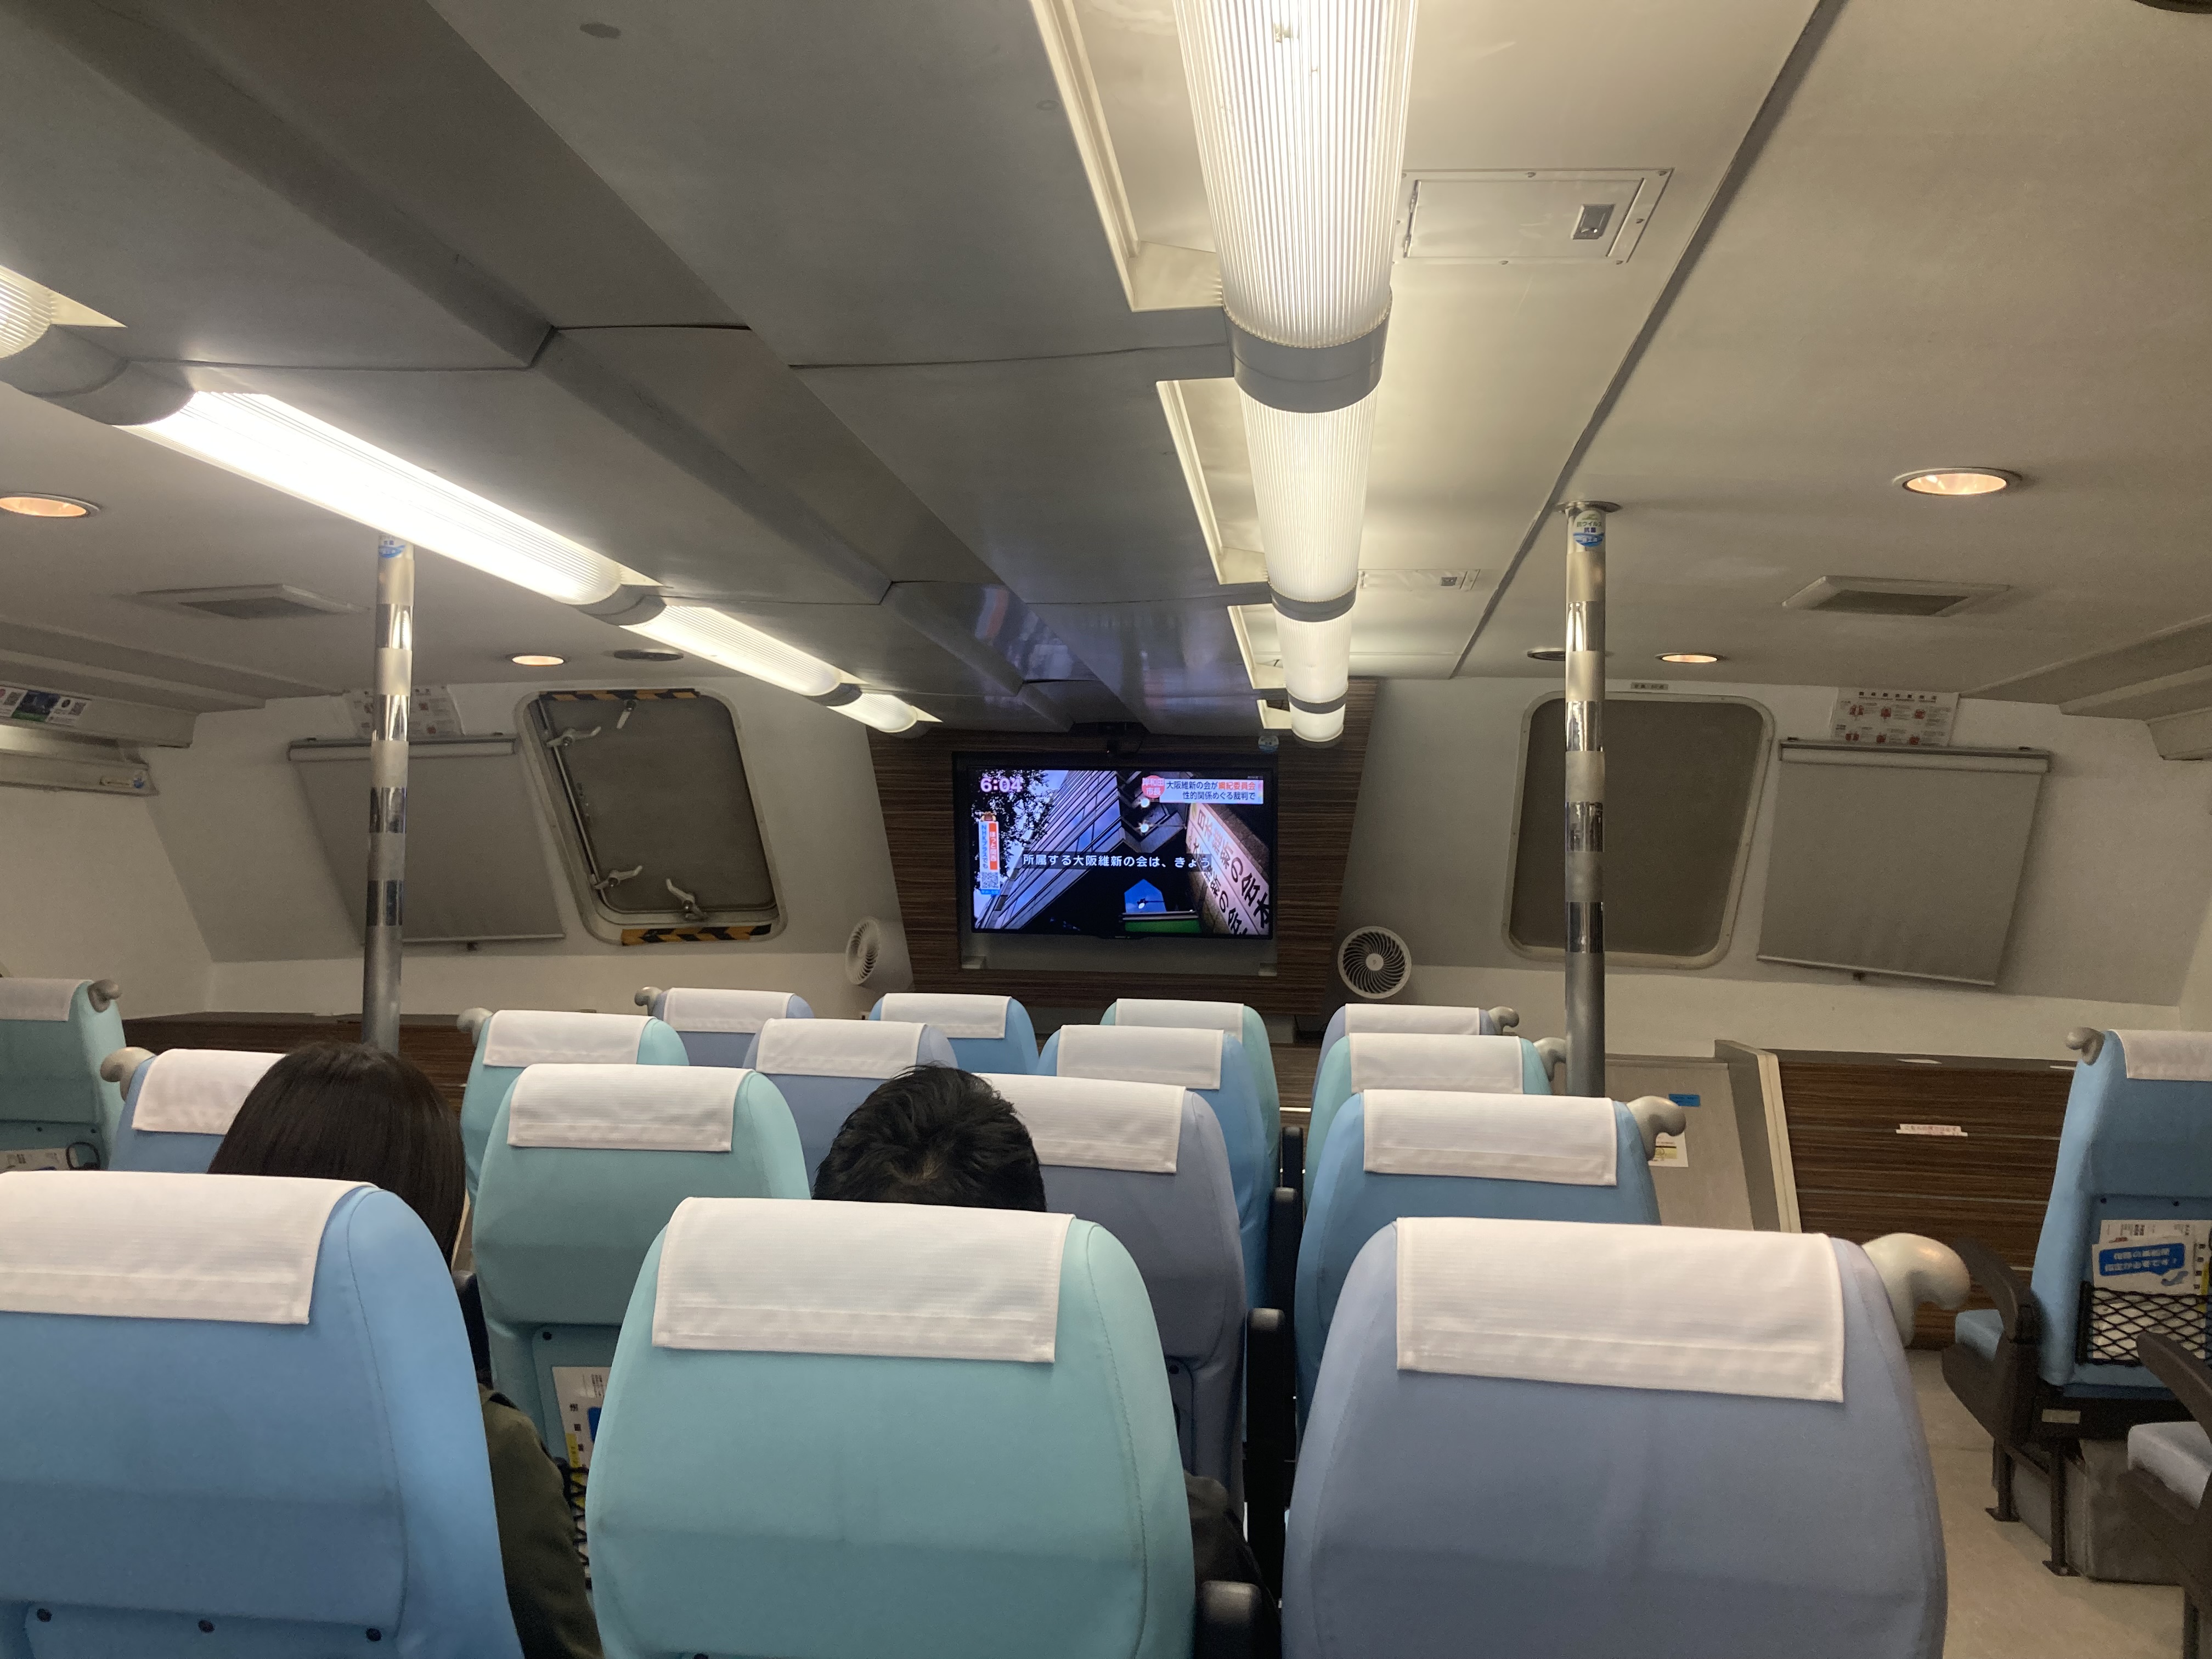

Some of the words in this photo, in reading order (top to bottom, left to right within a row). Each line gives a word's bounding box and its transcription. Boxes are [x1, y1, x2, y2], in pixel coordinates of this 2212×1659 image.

[980, 777, 1023, 793] 6:04
[1142, 777, 1165, 786] 岸和田
[1146, 787, 1161, 795] 市長
[1183, 791, 1255, 800] 性的関係めぐる裁判で
[1023, 854, 1210, 868] 所属する大阪維新の会は、きょう
